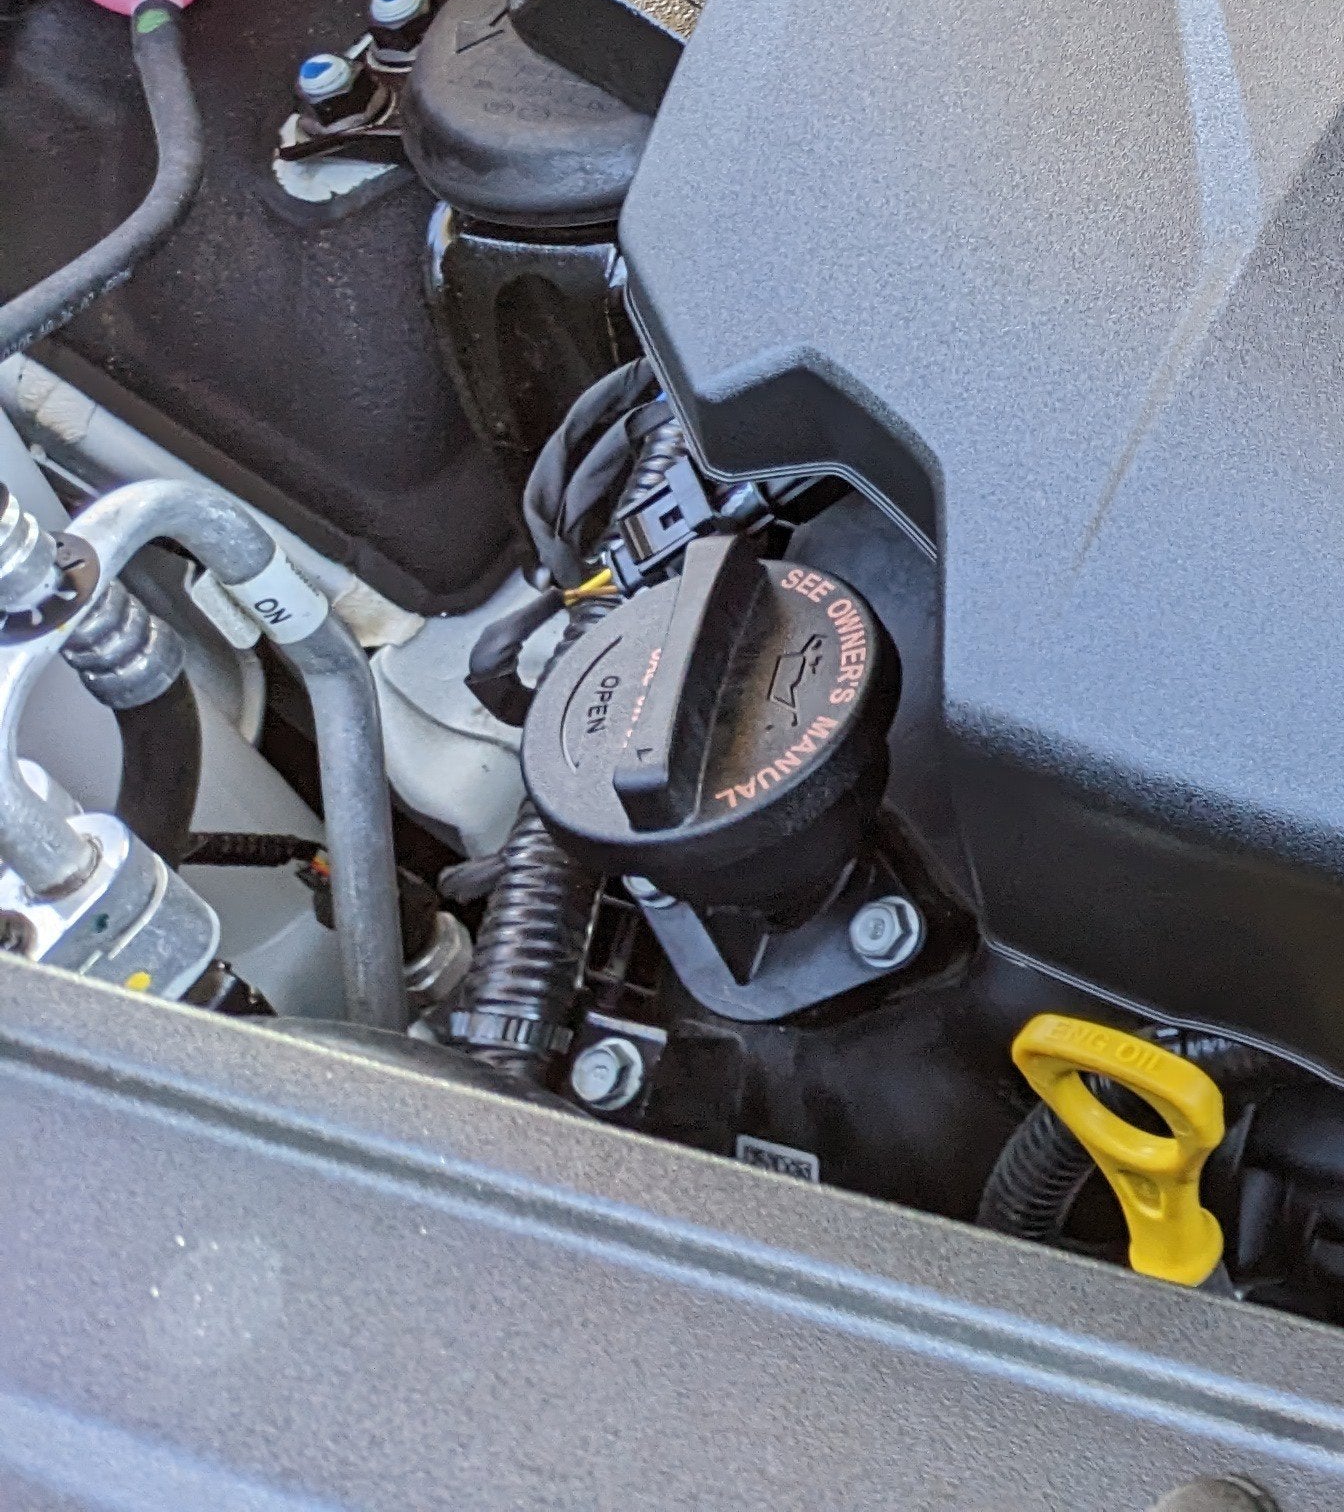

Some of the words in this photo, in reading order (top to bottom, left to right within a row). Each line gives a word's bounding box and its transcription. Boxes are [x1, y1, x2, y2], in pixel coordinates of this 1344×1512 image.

[781, 568, 834, 603] SEE
[827, 598, 867, 705] OWNER'S
[586, 675, 620, 735] OPEN
[715, 715, 839, 808] MANUAL
[1052, 1021, 1111, 1050] ENG
[1115, 1041, 1162, 1072] OIL
